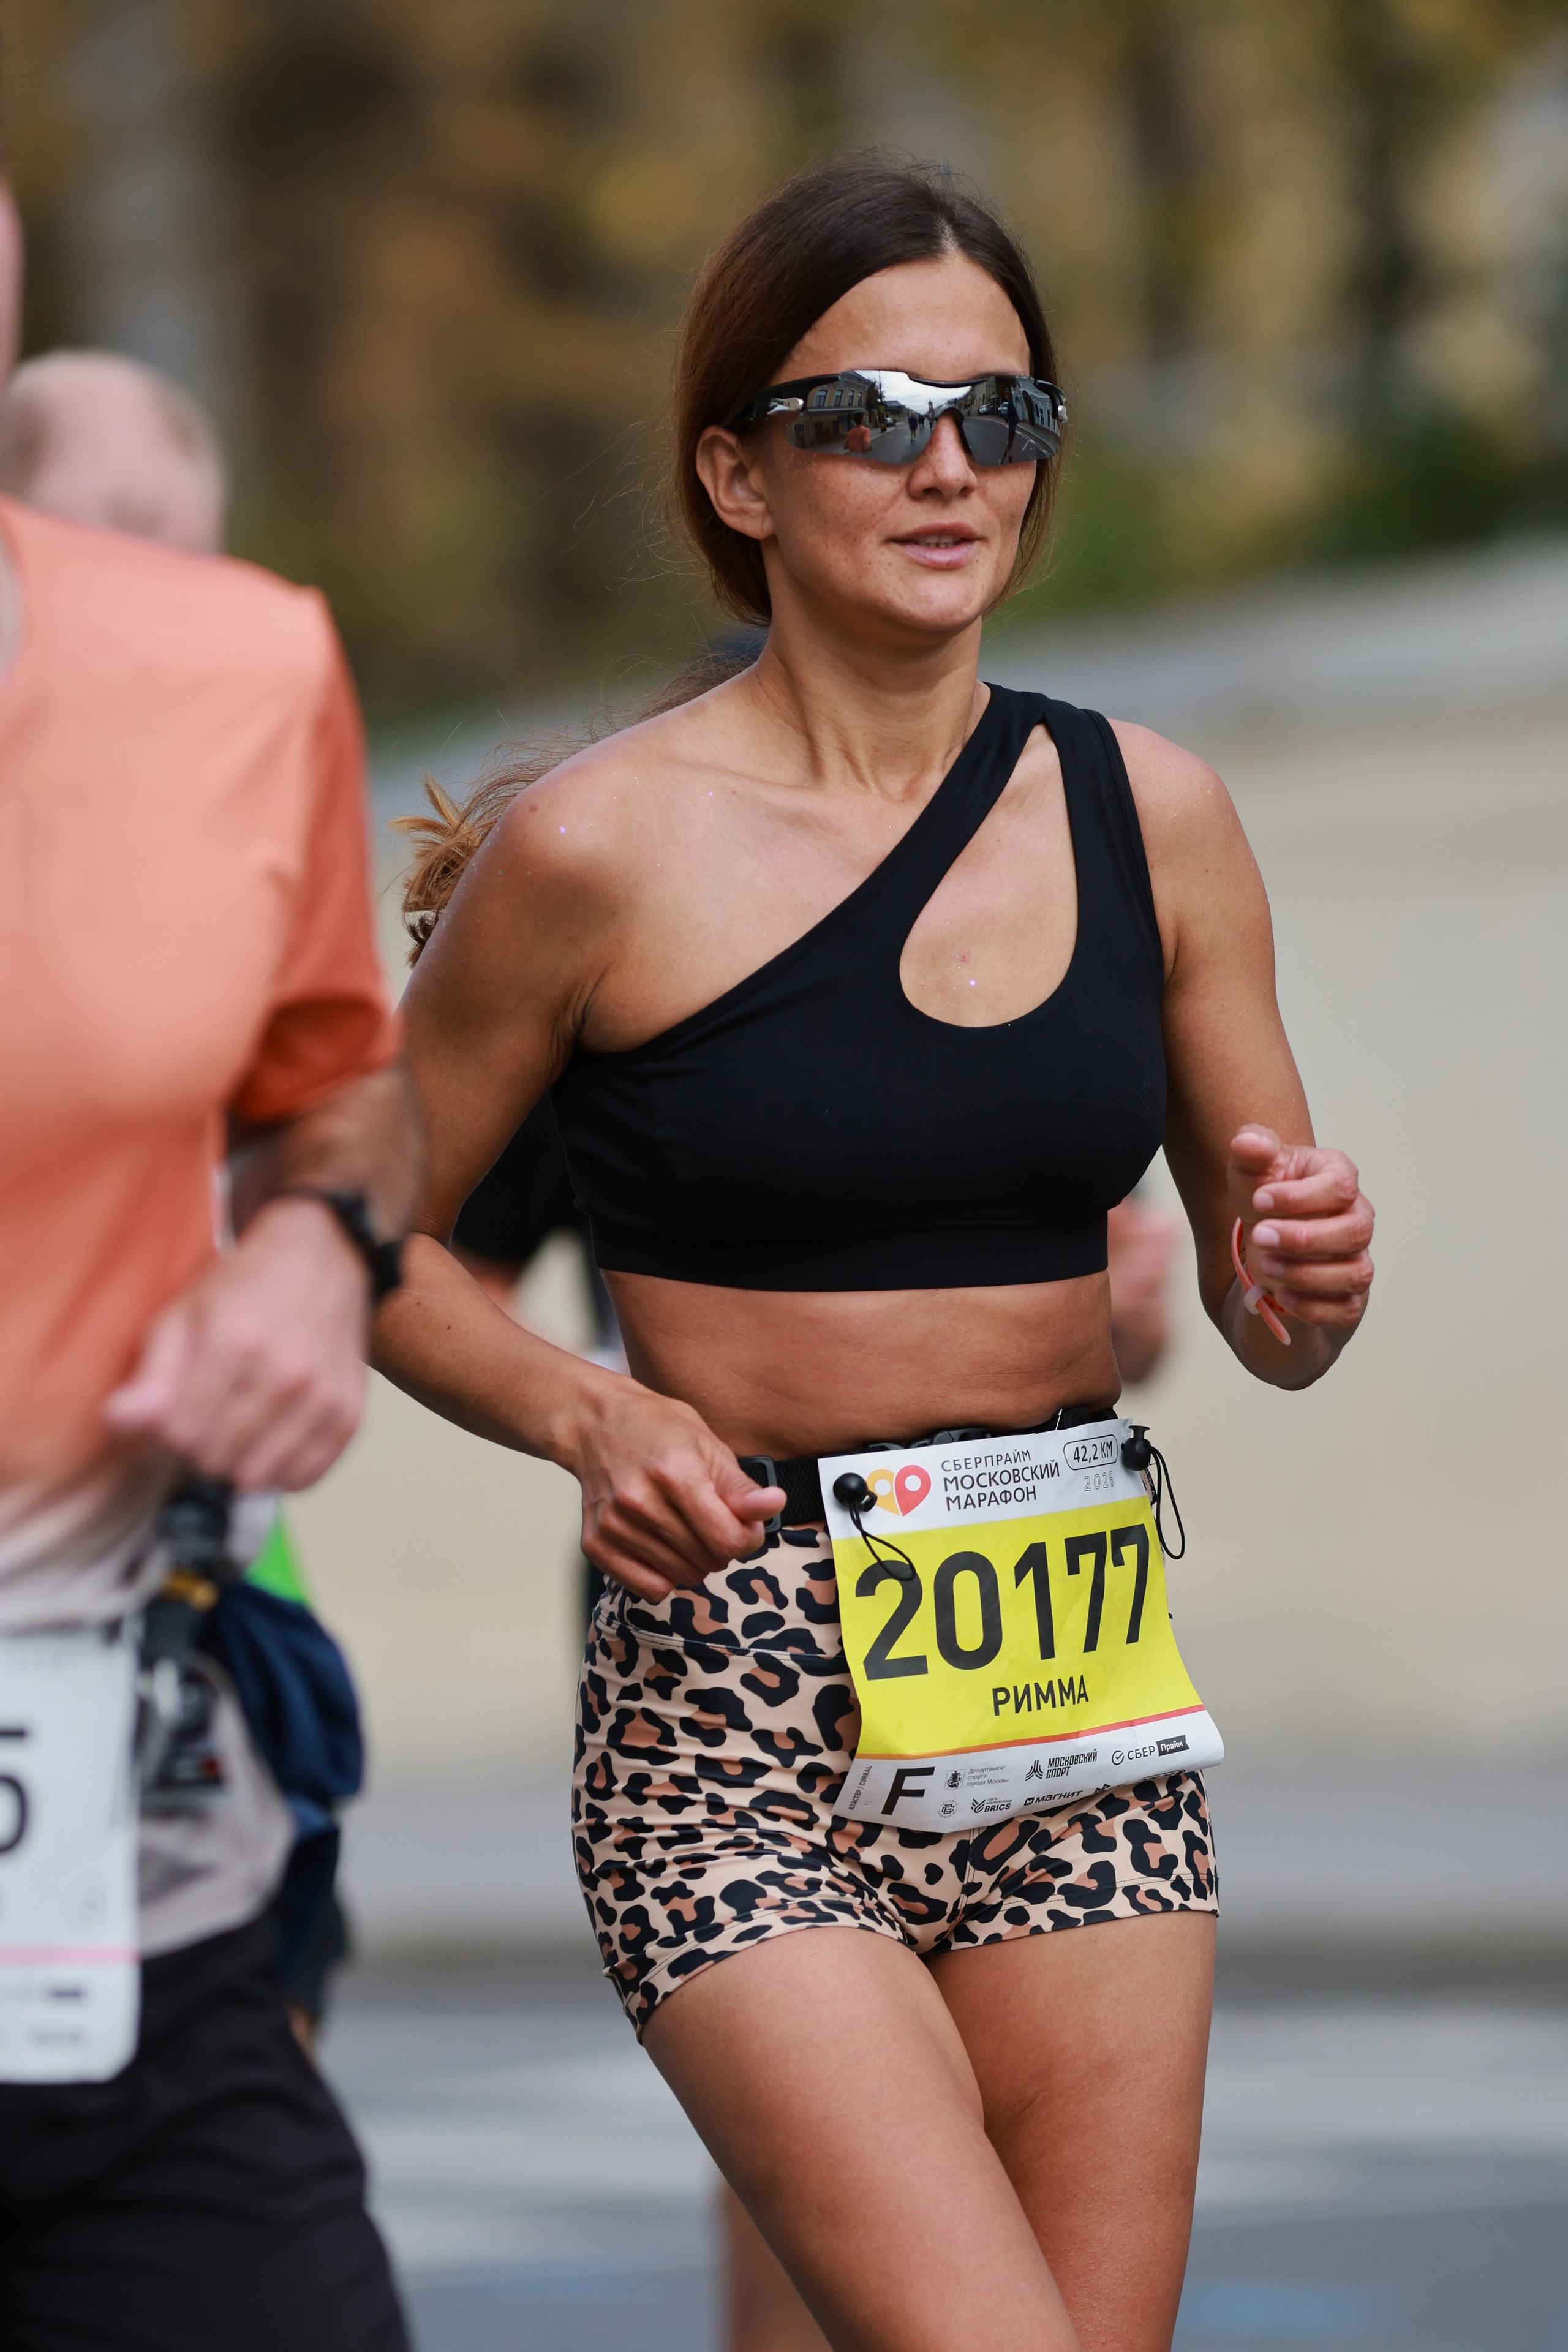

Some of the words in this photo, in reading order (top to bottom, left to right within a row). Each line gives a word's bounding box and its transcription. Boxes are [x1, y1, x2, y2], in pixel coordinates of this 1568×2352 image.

[941, 1449, 1031, 1472] СБЕРПРАЙМ
[1073, 1443, 1099, 1464] 42,2
[1101, 1441, 1113, 1459] КМ
[943, 1459, 1060, 1492] МОСКОВСКИЙ
[946, 1485, 1037, 1512] МАРАФОН
[855, 1523, 1150, 1681] 20177
[992, 1674, 1090, 1717] РИММА
[1047, 1749, 1098, 1769] МОСКОВСКИЙ
[1127, 1745, 1155, 1760] СБЕР
[1160, 1740, 1183, 1752] Прайм
[859, 1765, 873, 1787] CORRAL
[968, 1765, 1006, 1774] Департамент
[1046, 1766, 1071, 1779] СПОРТ
[881, 1766, 935, 1815] F
[984, 1803, 1011, 1812] BRICS
